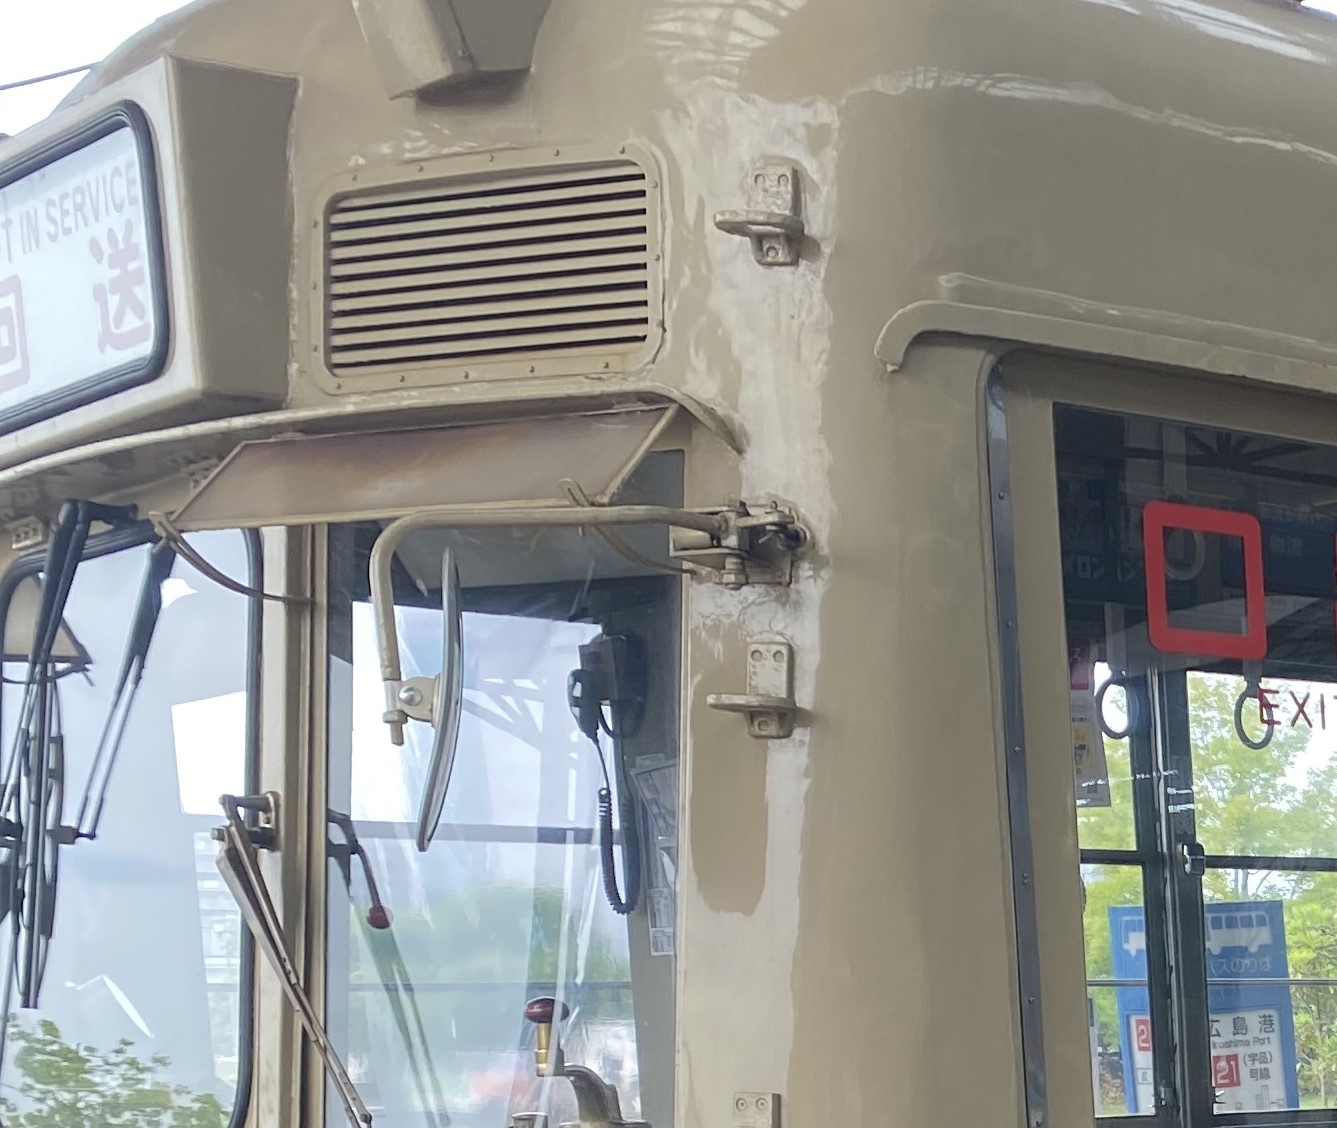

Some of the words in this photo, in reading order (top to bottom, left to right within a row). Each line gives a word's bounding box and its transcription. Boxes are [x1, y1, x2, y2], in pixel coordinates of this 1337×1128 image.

[19, 206, 40, 255] IN
[45, 160, 139, 243] SERVICE
[1253, 1036, 1271, 1046] Port
[1217, 1060, 1237, 1084] 21
